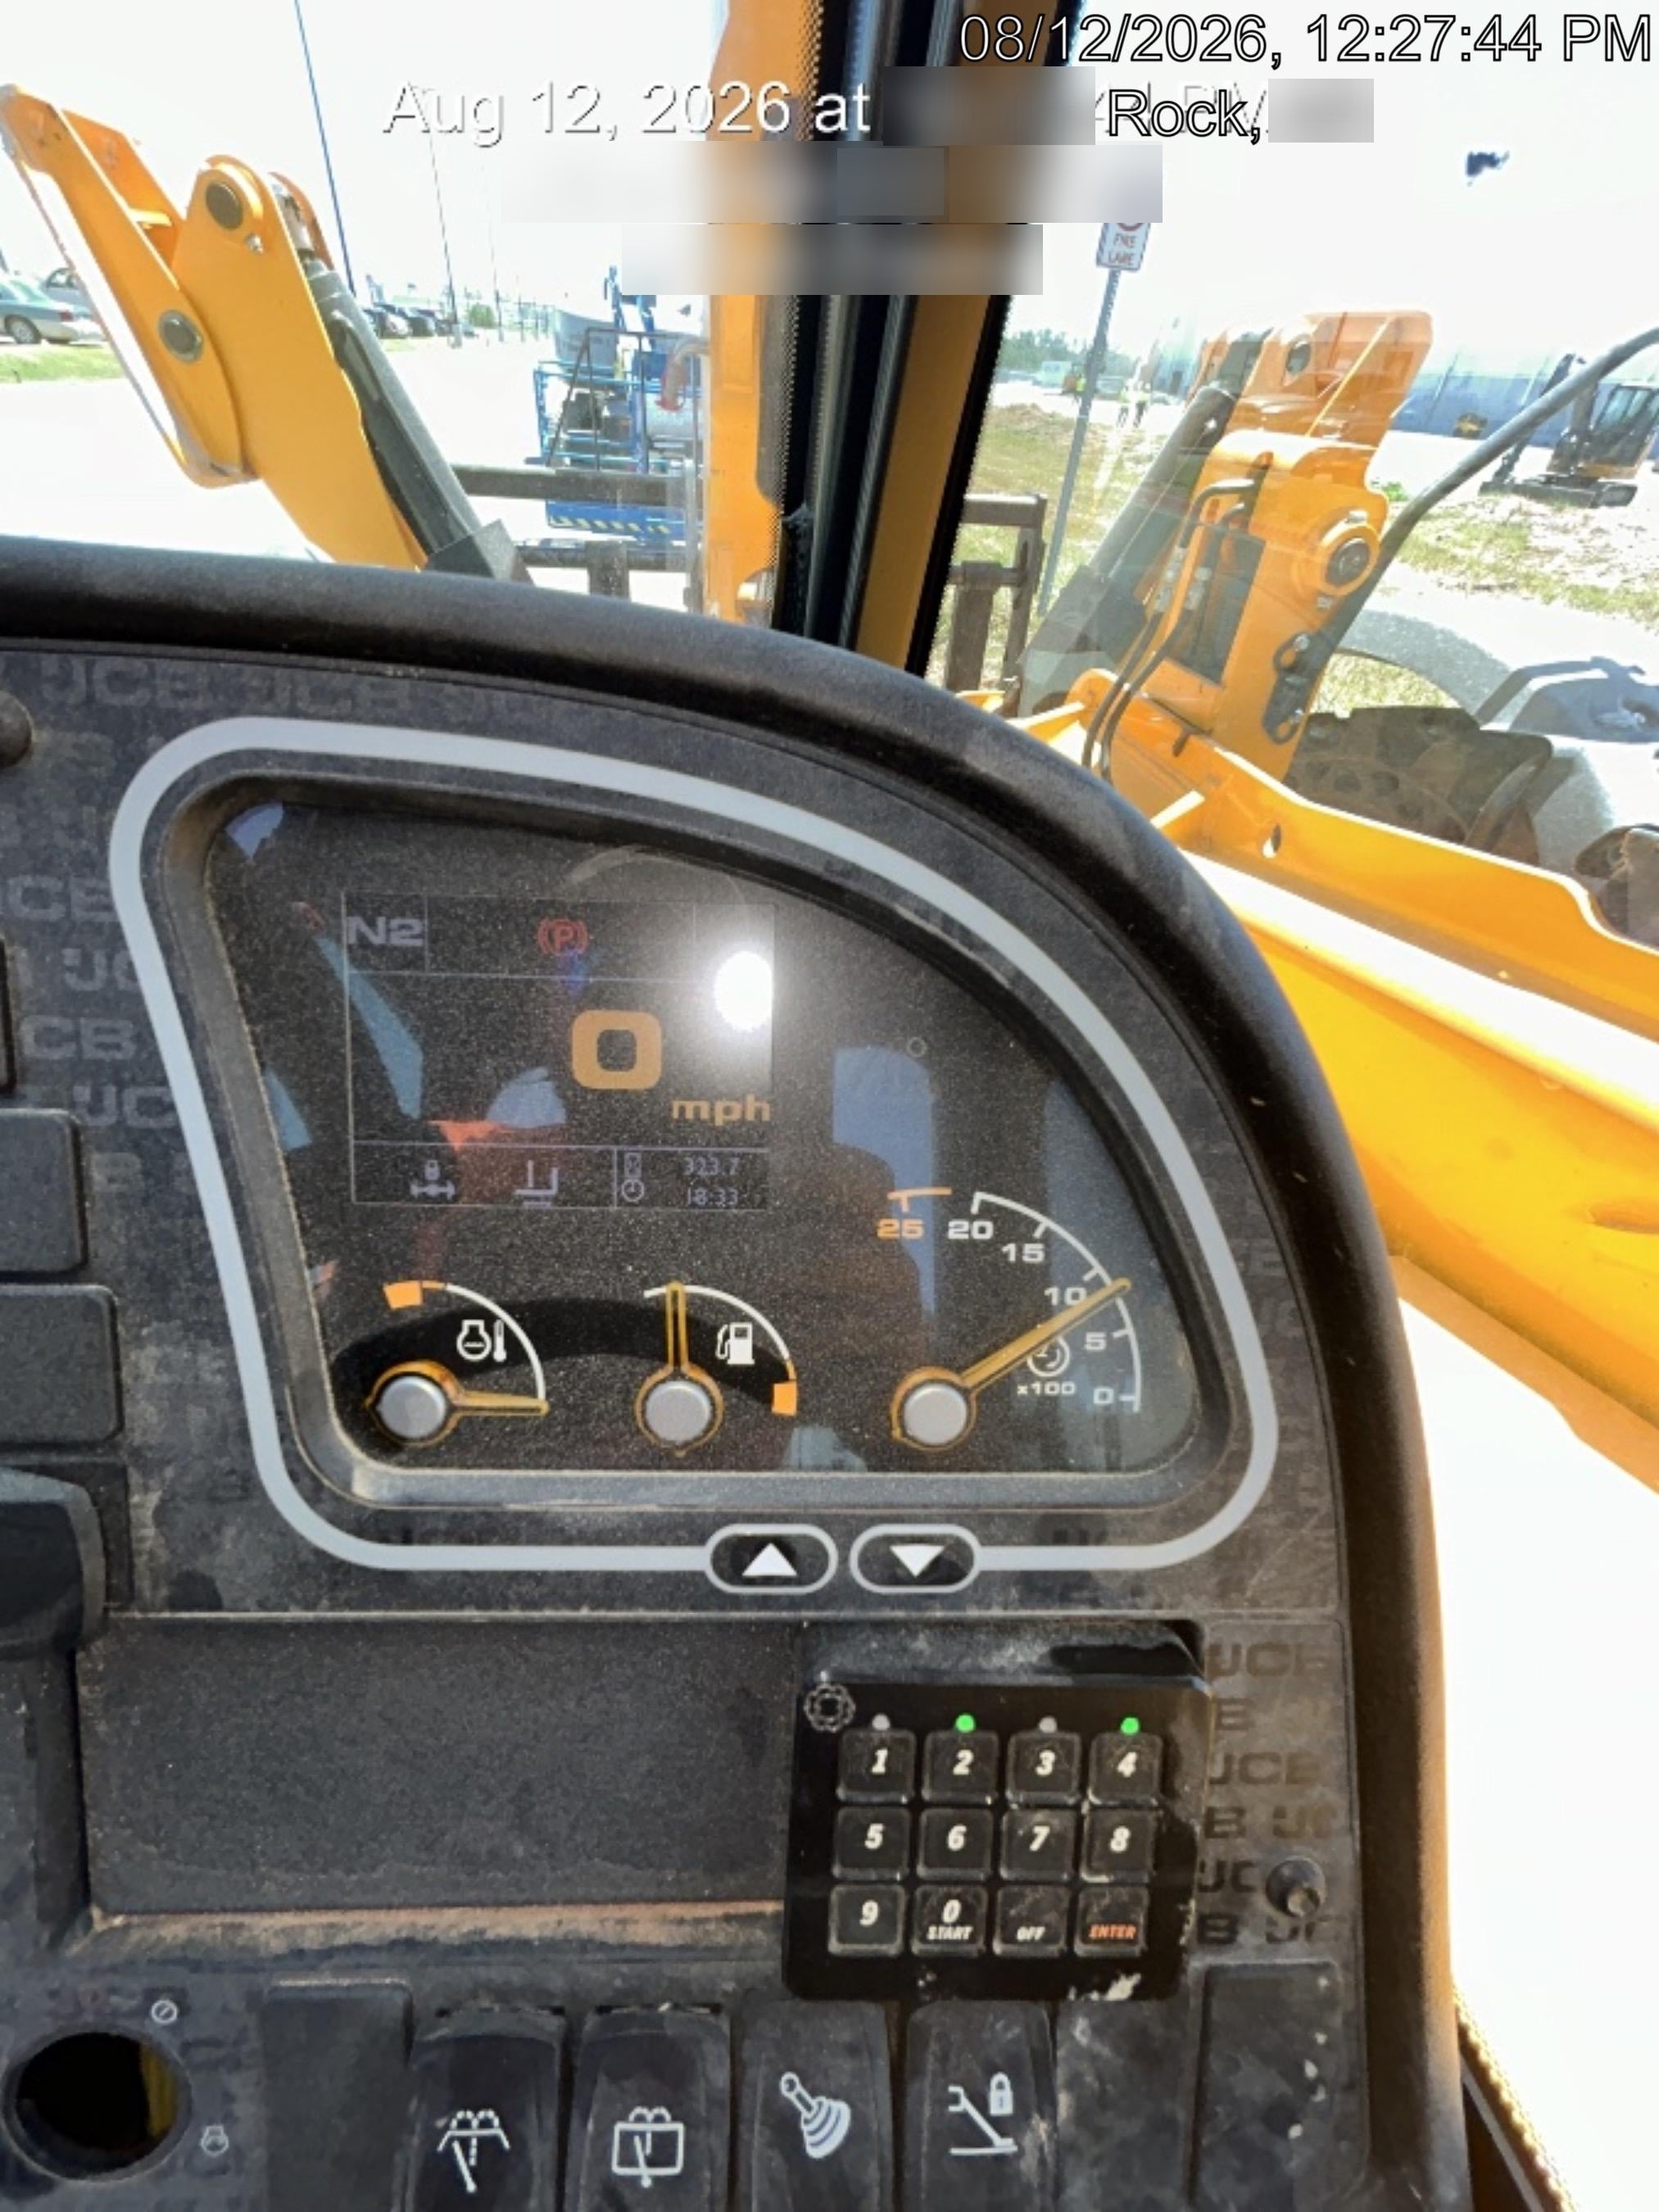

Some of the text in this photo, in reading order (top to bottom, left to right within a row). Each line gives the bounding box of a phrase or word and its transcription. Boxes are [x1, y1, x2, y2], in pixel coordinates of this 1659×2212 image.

[347, 916, 424, 947] N2
[572, 1009, 663, 1090] 0
[671, 1093, 773, 1127] mph
[877, 1218, 924, 1240] 25
[947, 1220, 994, 1240] 20
[1001, 1243, 1045, 1263] 15
[1044, 1286, 1087, 1307] 10
[1084, 1332, 1108, 1352] 5
[1016, 1381, 1076, 1397] x100
[1093, 1386, 1114, 1404] 0
[871, 1748, 889, 1775] 1
[953, 1750, 974, 1776] 2
[1036, 1750, 1056, 1776] 3
[1117, 1751, 1138, 1777] 4
[864, 1824, 884, 1850] 5
[947, 1824, 967, 1851] 6
[1029, 1826, 1050, 1852] 7
[1109, 1827, 1131, 1853] 8
[859, 1900, 879, 1926] 9
[941, 1899, 961, 1924] 0
[927, 1924, 973, 1942] START
[1017, 1925, 1045, 1942] OFF
[1089, 1924, 1137, 1940] ENTER
